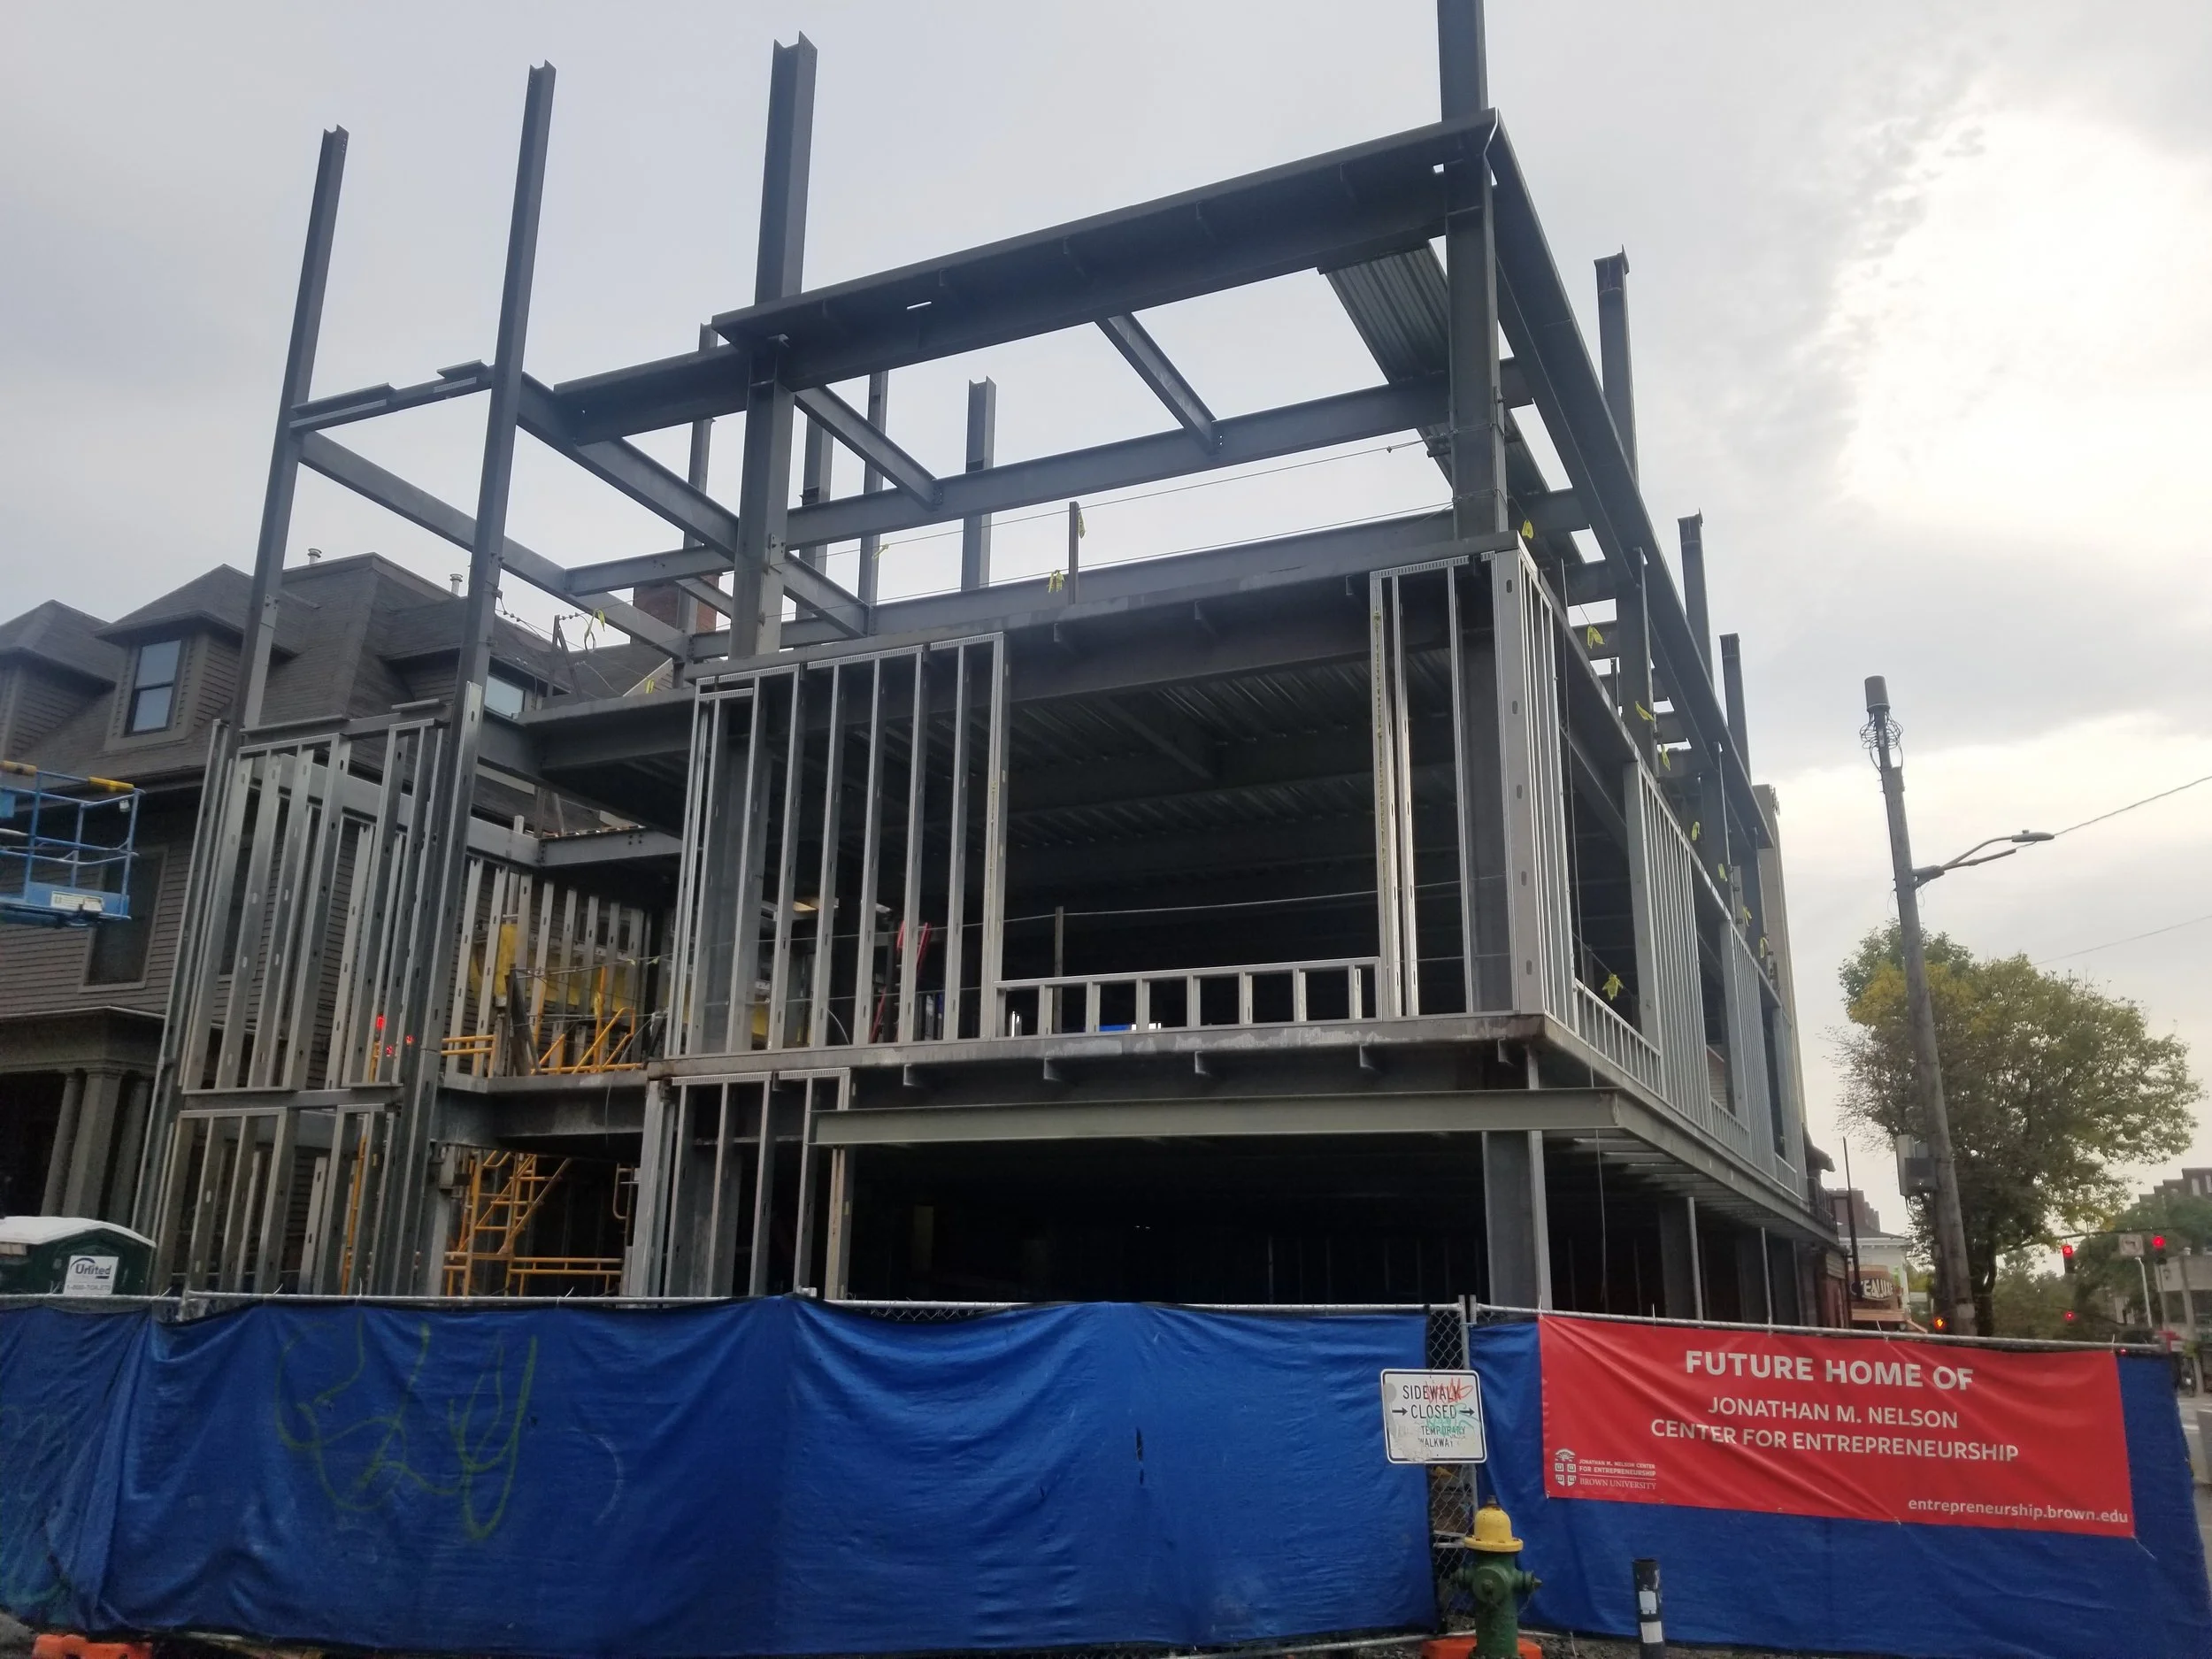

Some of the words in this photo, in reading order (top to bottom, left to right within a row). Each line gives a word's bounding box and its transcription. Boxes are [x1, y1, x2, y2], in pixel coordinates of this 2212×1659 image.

[75, 1263, 111, 1275] United
[1860, 1278, 1893, 1298] EALUXE
[1686, 1350, 1814, 1381] FUTURE
[1825, 1359, 1924, 1387] HOME
[1932, 1365, 1974, 1391] OF
[1402, 1385, 1461, 1400] SIDEWALK
[1410, 1404, 1457, 1419] CLOSED
[1708, 1396, 1829, 1422] JONATHAN
[1836, 1405, 1862, 1425] M.
[1869, 1406, 1958, 1429] NELSON
[1421, 1425, 1466, 1435] TEMPORARY
[1650, 1417, 1738, 1445] CENTER
[1742, 1429, 1787, 1448] FOR
[1793, 1432, 2020, 1463] ENTREPRENEURSHIP
[1594, 1467, 1656, 1477] ENTREPRENEURSHIP
[1580, 1478, 1609, 1486] BROWN
[1610, 1480, 1656, 1490] UNIVERSITY
[1908, 1498, 2129, 1524] entrepreneurship.brown.edu
